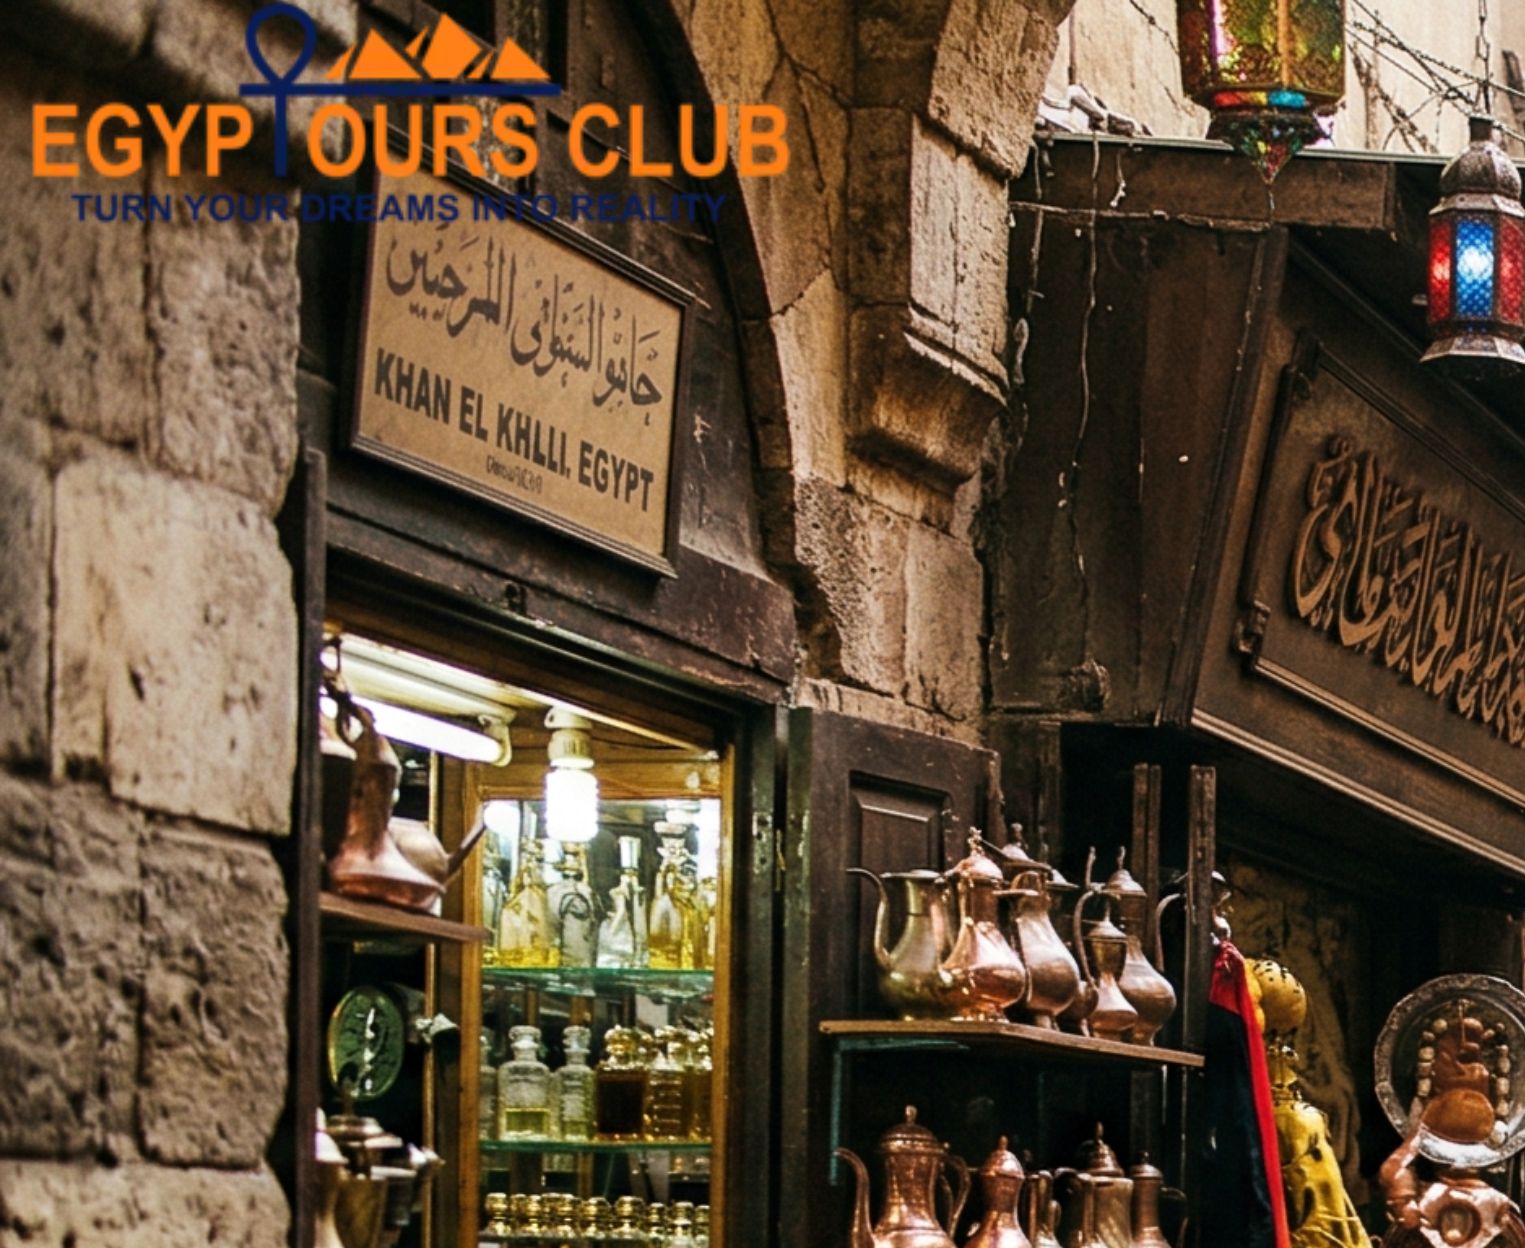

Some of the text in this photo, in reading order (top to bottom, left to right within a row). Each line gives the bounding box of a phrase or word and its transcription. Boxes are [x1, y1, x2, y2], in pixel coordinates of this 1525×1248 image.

[375, 348, 450, 424] KHAN
[459, 386, 489, 442] EL
[578, 441, 654, 513] EGYPT
